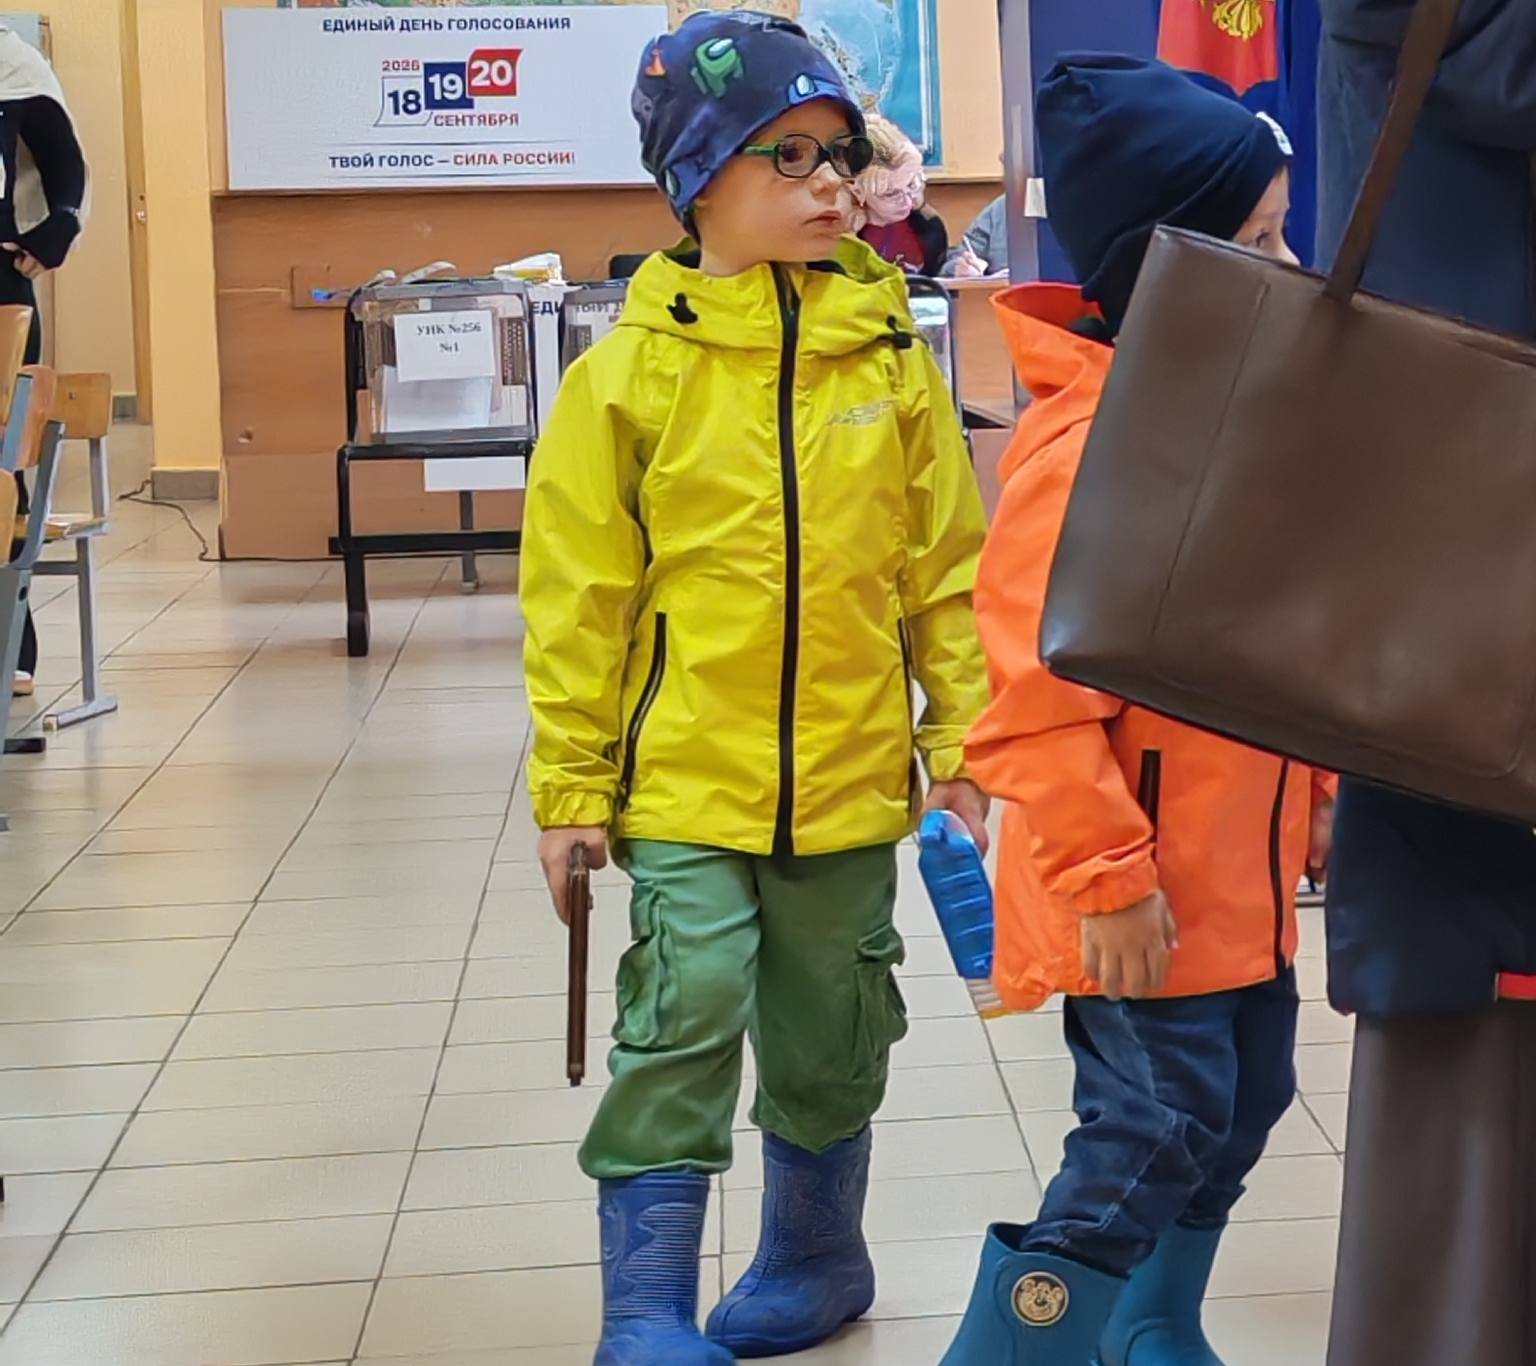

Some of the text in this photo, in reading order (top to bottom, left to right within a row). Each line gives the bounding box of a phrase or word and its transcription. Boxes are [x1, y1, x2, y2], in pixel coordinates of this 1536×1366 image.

[322, 16, 571, 33] ЕДИНЫЙ ДЕНЬ ГОЛОСОВАНИЯ
[387, 59, 513, 116] 18 19 20
[433, 112, 520, 127] СЕНТЯБРЯ
[329, 153, 374, 168] ТВОЙ
[378, 154, 434, 167] ГОЛОС
[453, 153, 498, 166] СИЛА
[503, 151, 575, 165] РОССИИ!
[416, 323, 445, 336] УИК
